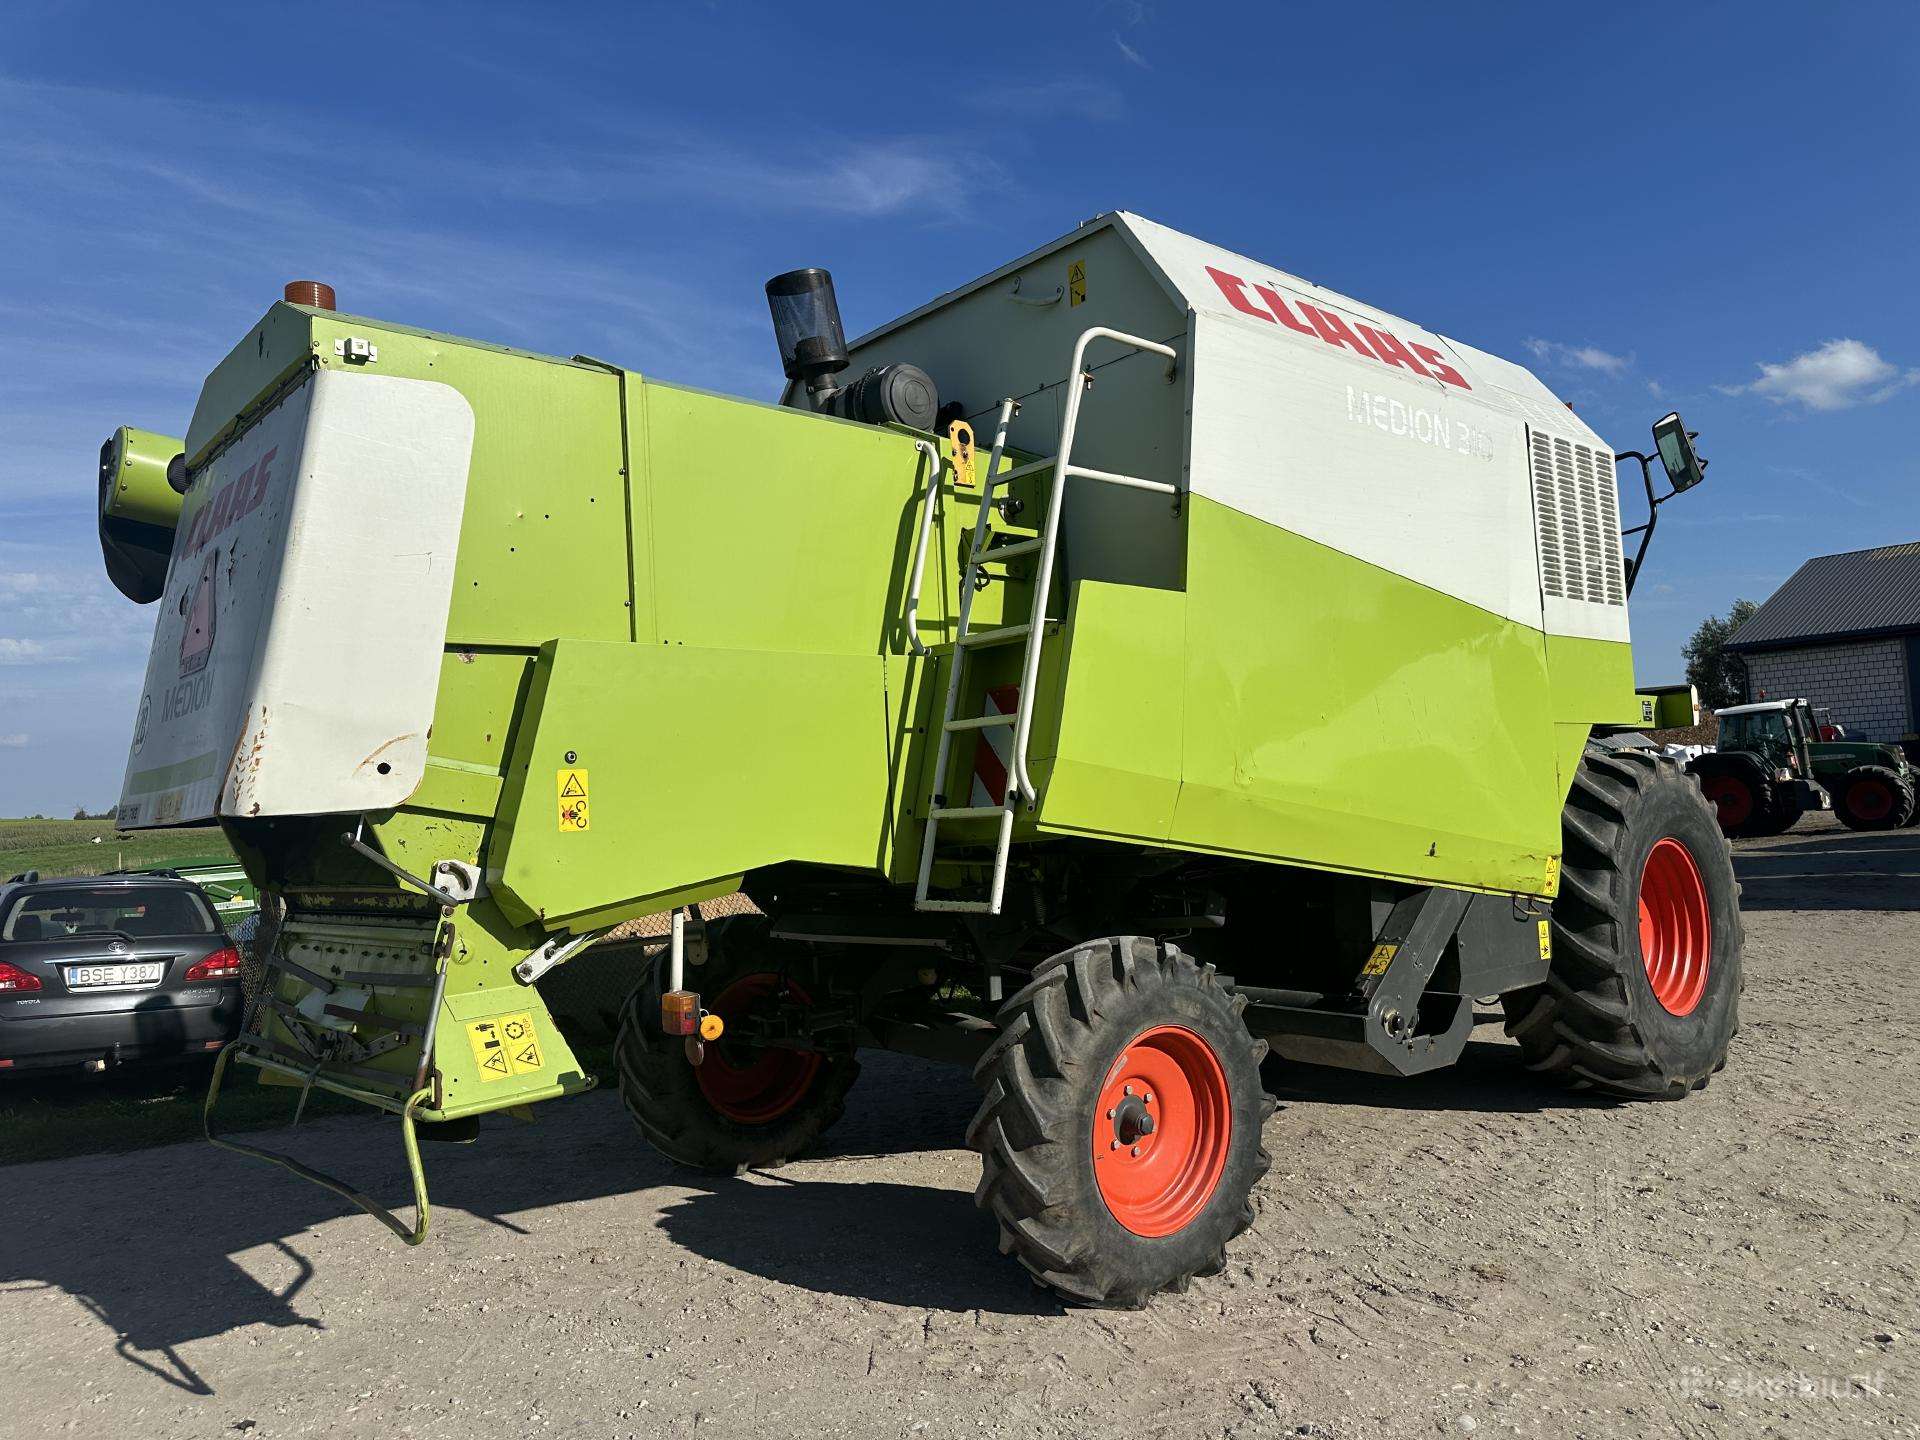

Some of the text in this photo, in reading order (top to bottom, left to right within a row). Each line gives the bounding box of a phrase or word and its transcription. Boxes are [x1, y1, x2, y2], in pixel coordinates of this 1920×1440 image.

[1204, 265, 1473, 391] CLAAS
[1346, 385, 1450, 449] MEDION
[181, 444, 279, 561] CLAAS
[160, 669, 215, 723] MEDION
[80, 965, 156, 983] BSE Y387
[522, 1018, 534, 1039] STOP
